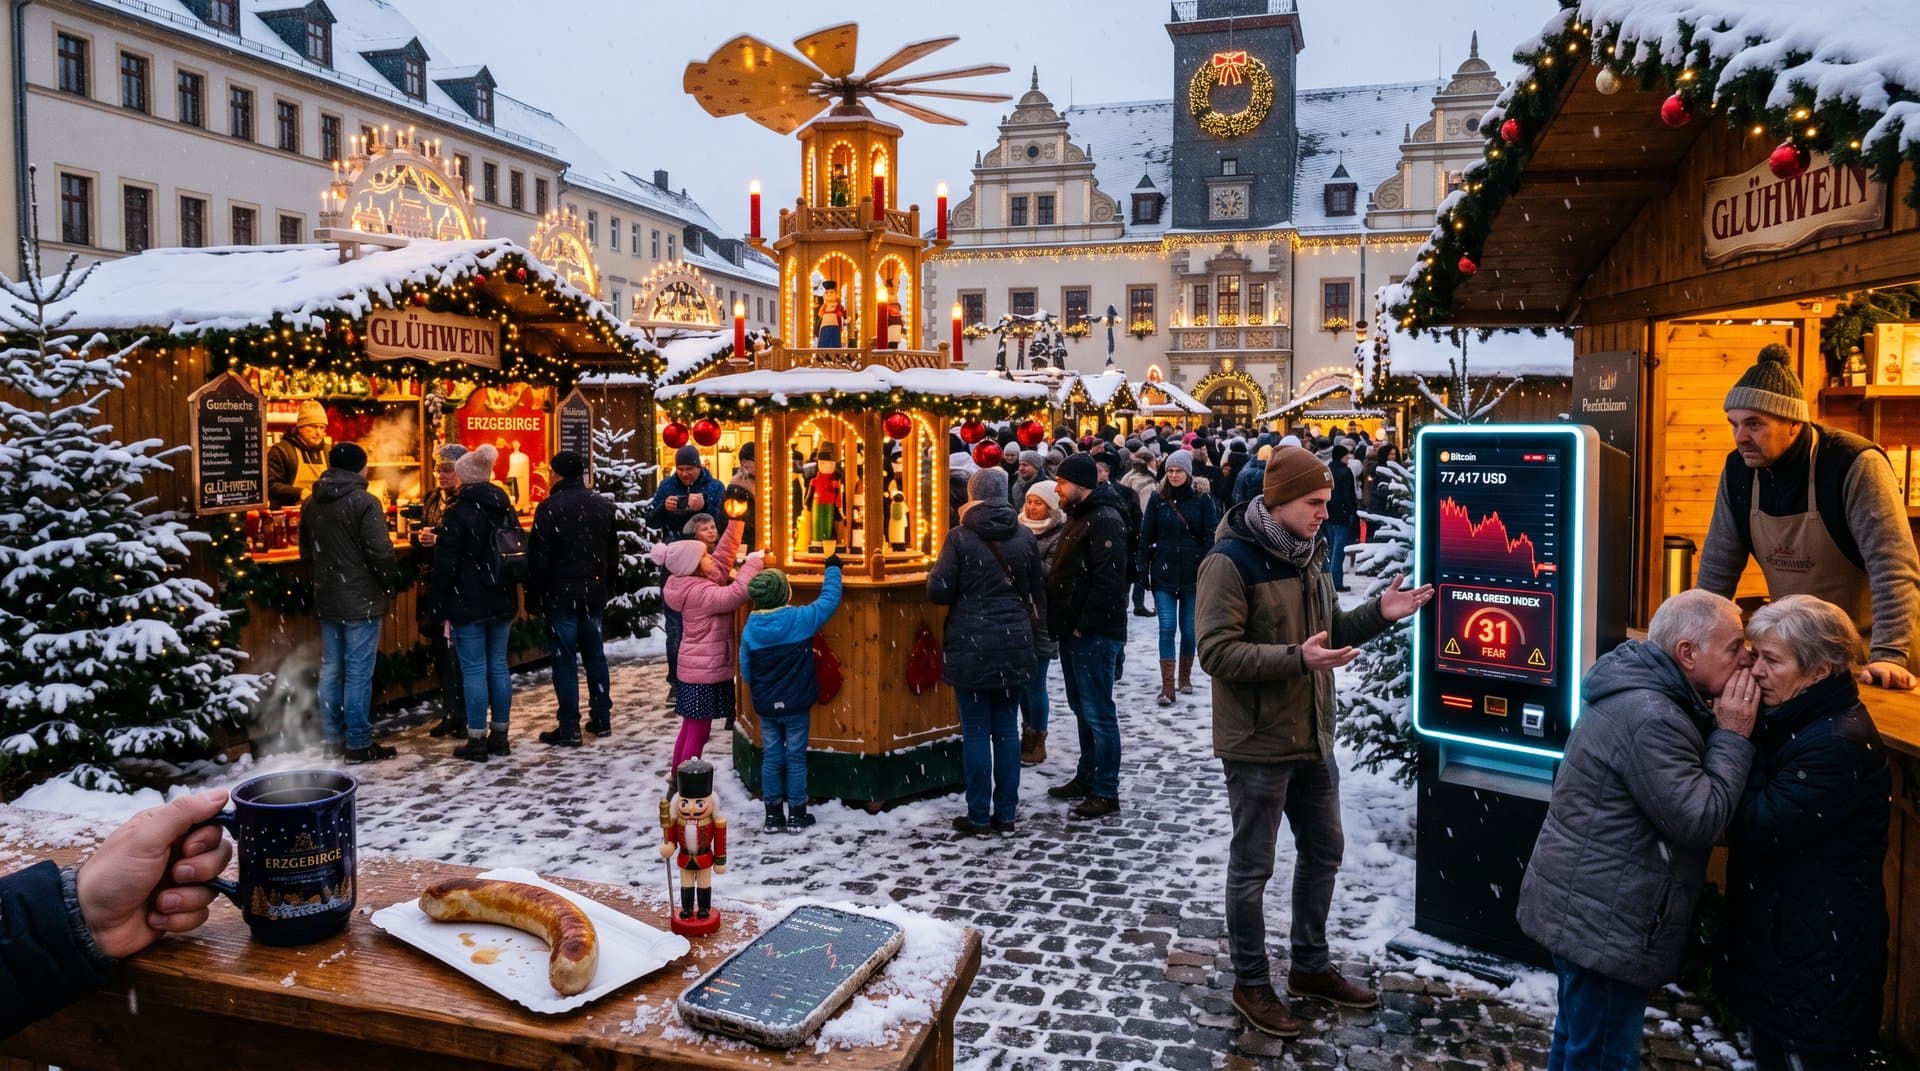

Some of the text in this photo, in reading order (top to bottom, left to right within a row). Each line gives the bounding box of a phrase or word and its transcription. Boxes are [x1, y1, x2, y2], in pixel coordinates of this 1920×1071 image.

[1712, 165, 1867, 240] GLÜHWEIN
[371, 314, 494, 356] GLÜHWEIN
[467, 417, 540, 431] ERZGEBIRGE
[1450, 453, 1477, 462] Bitcoin
[1440, 472, 1507, 485] 77,417 USD
[204, 480, 257, 494] GLÜHWEIN
[1452, 591, 1474, 602] FEAR
[1482, 595, 1511, 605] GREED
[1512, 598, 1540, 608] INDEX
[1479, 618, 1508, 645] 31
[1482, 647, 1506, 659] FEAR
[265, 848, 342, 869] ERZGEBIRGE
